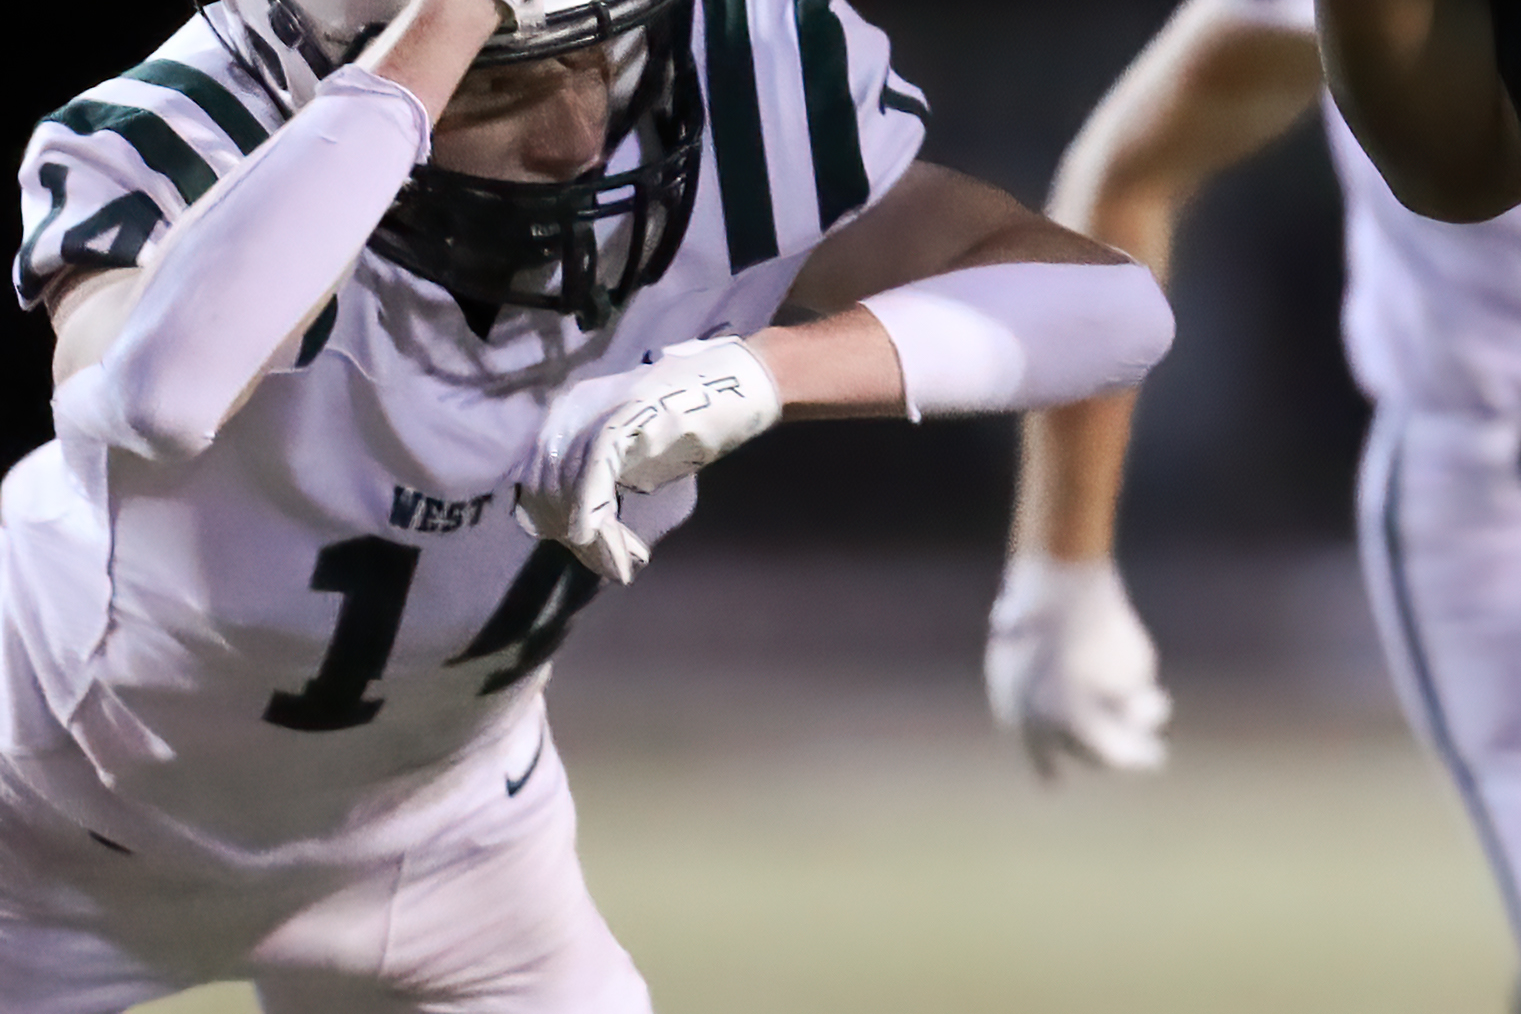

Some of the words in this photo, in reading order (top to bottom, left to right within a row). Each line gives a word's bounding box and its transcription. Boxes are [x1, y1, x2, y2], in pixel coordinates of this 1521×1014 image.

[16, 162, 170, 300] 14
[389, 485, 495, 533] WEST
[260, 534, 602, 733] 14
